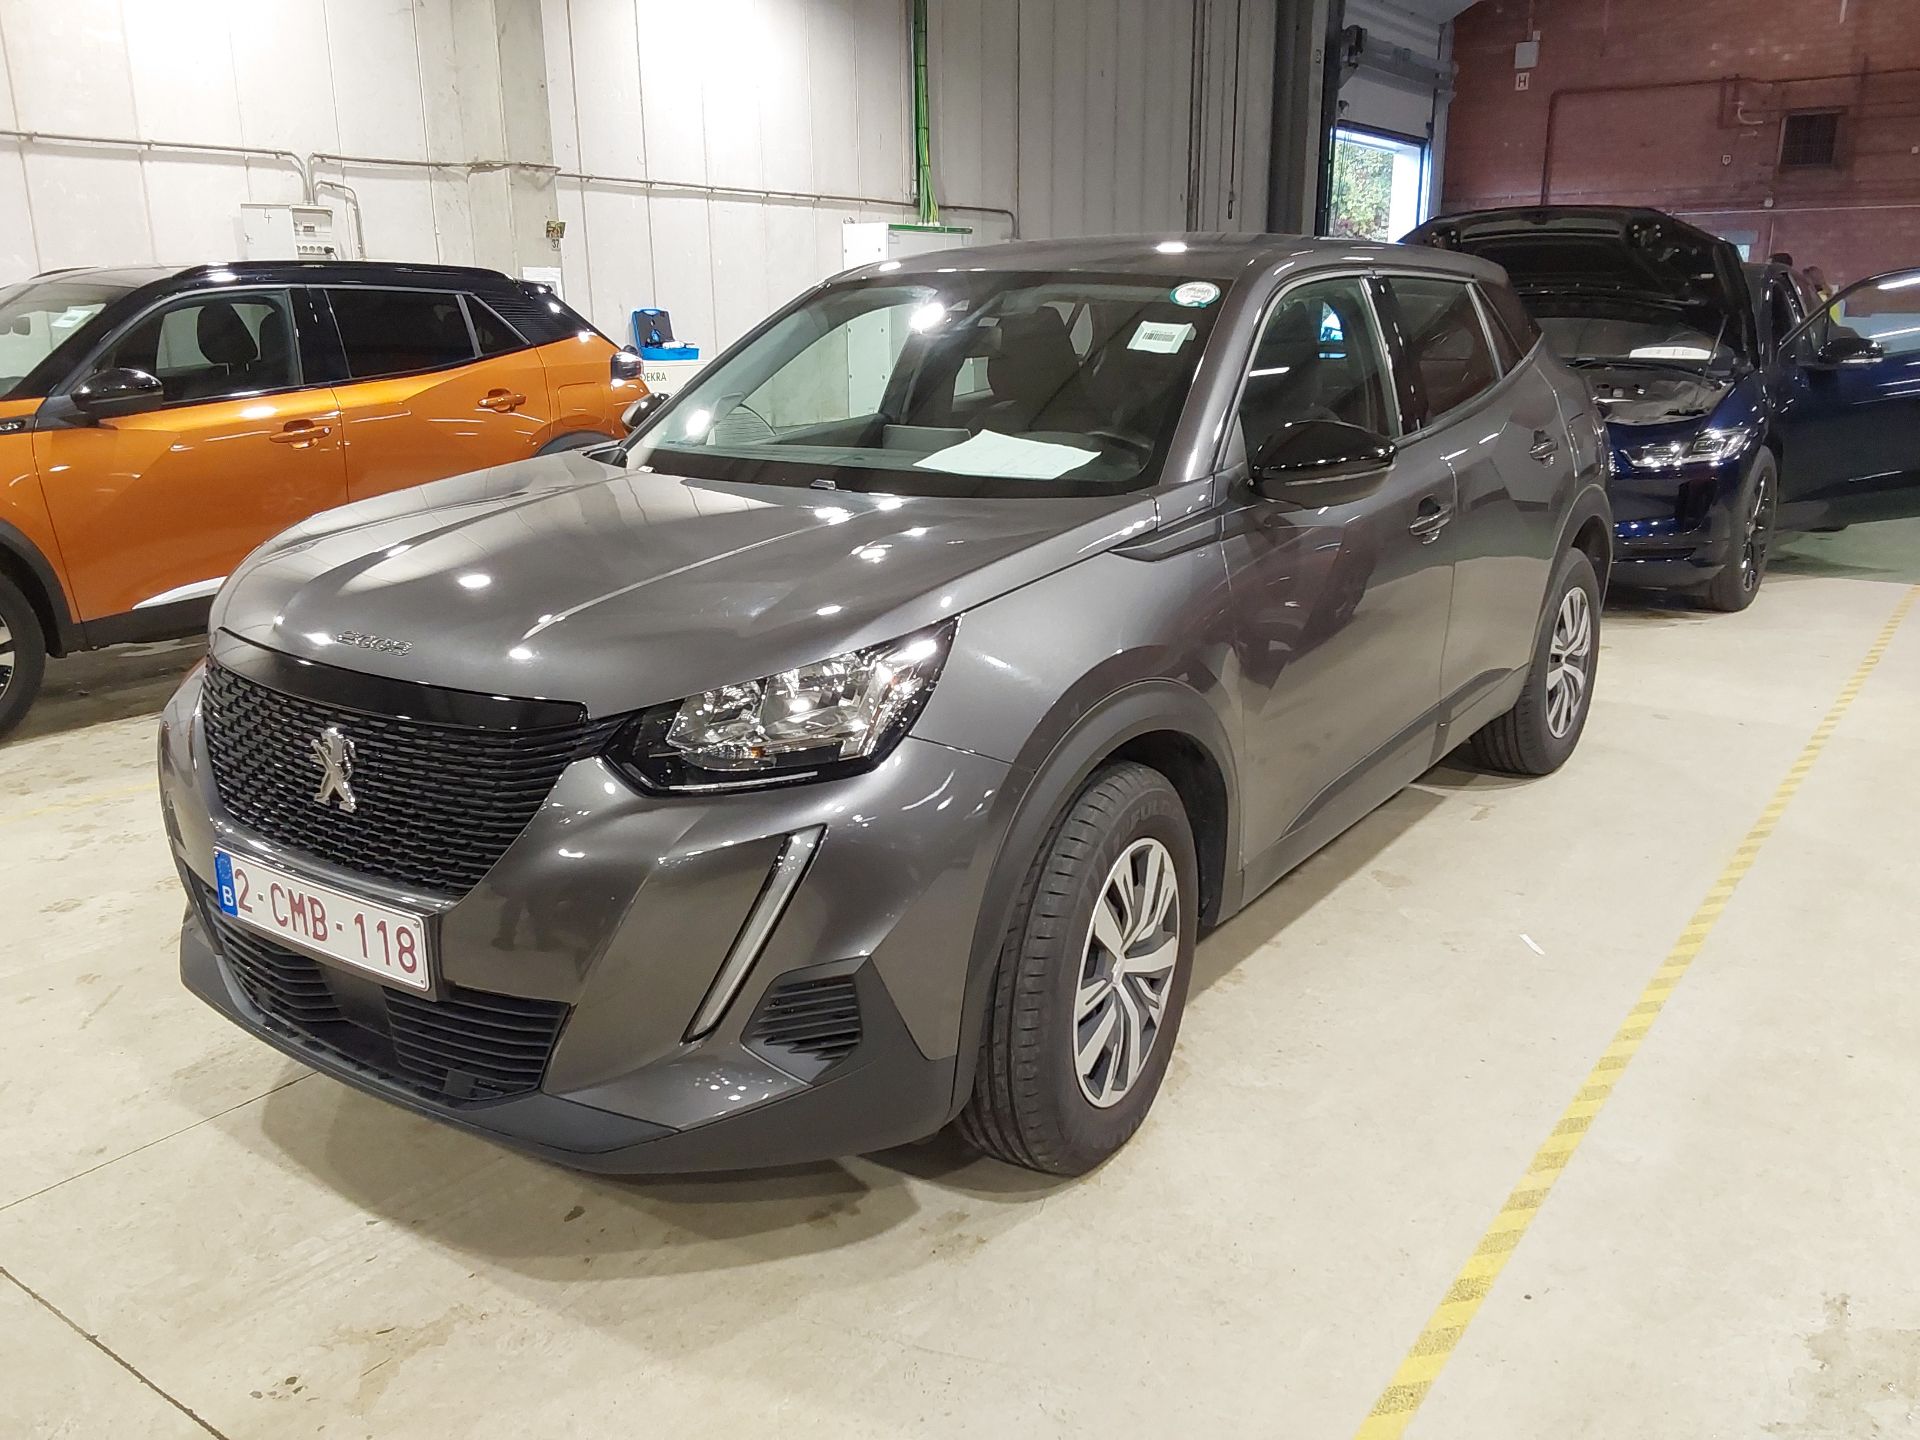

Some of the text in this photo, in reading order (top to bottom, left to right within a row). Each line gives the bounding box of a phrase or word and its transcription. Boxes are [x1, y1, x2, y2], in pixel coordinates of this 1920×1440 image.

[1517, 74, 1527, 88] H
[551, 238, 560, 249] 37
[335, 630, 413, 657] 2008
[222, 885, 234, 907] B
[234, 868, 417, 974] 2-CMB-118
